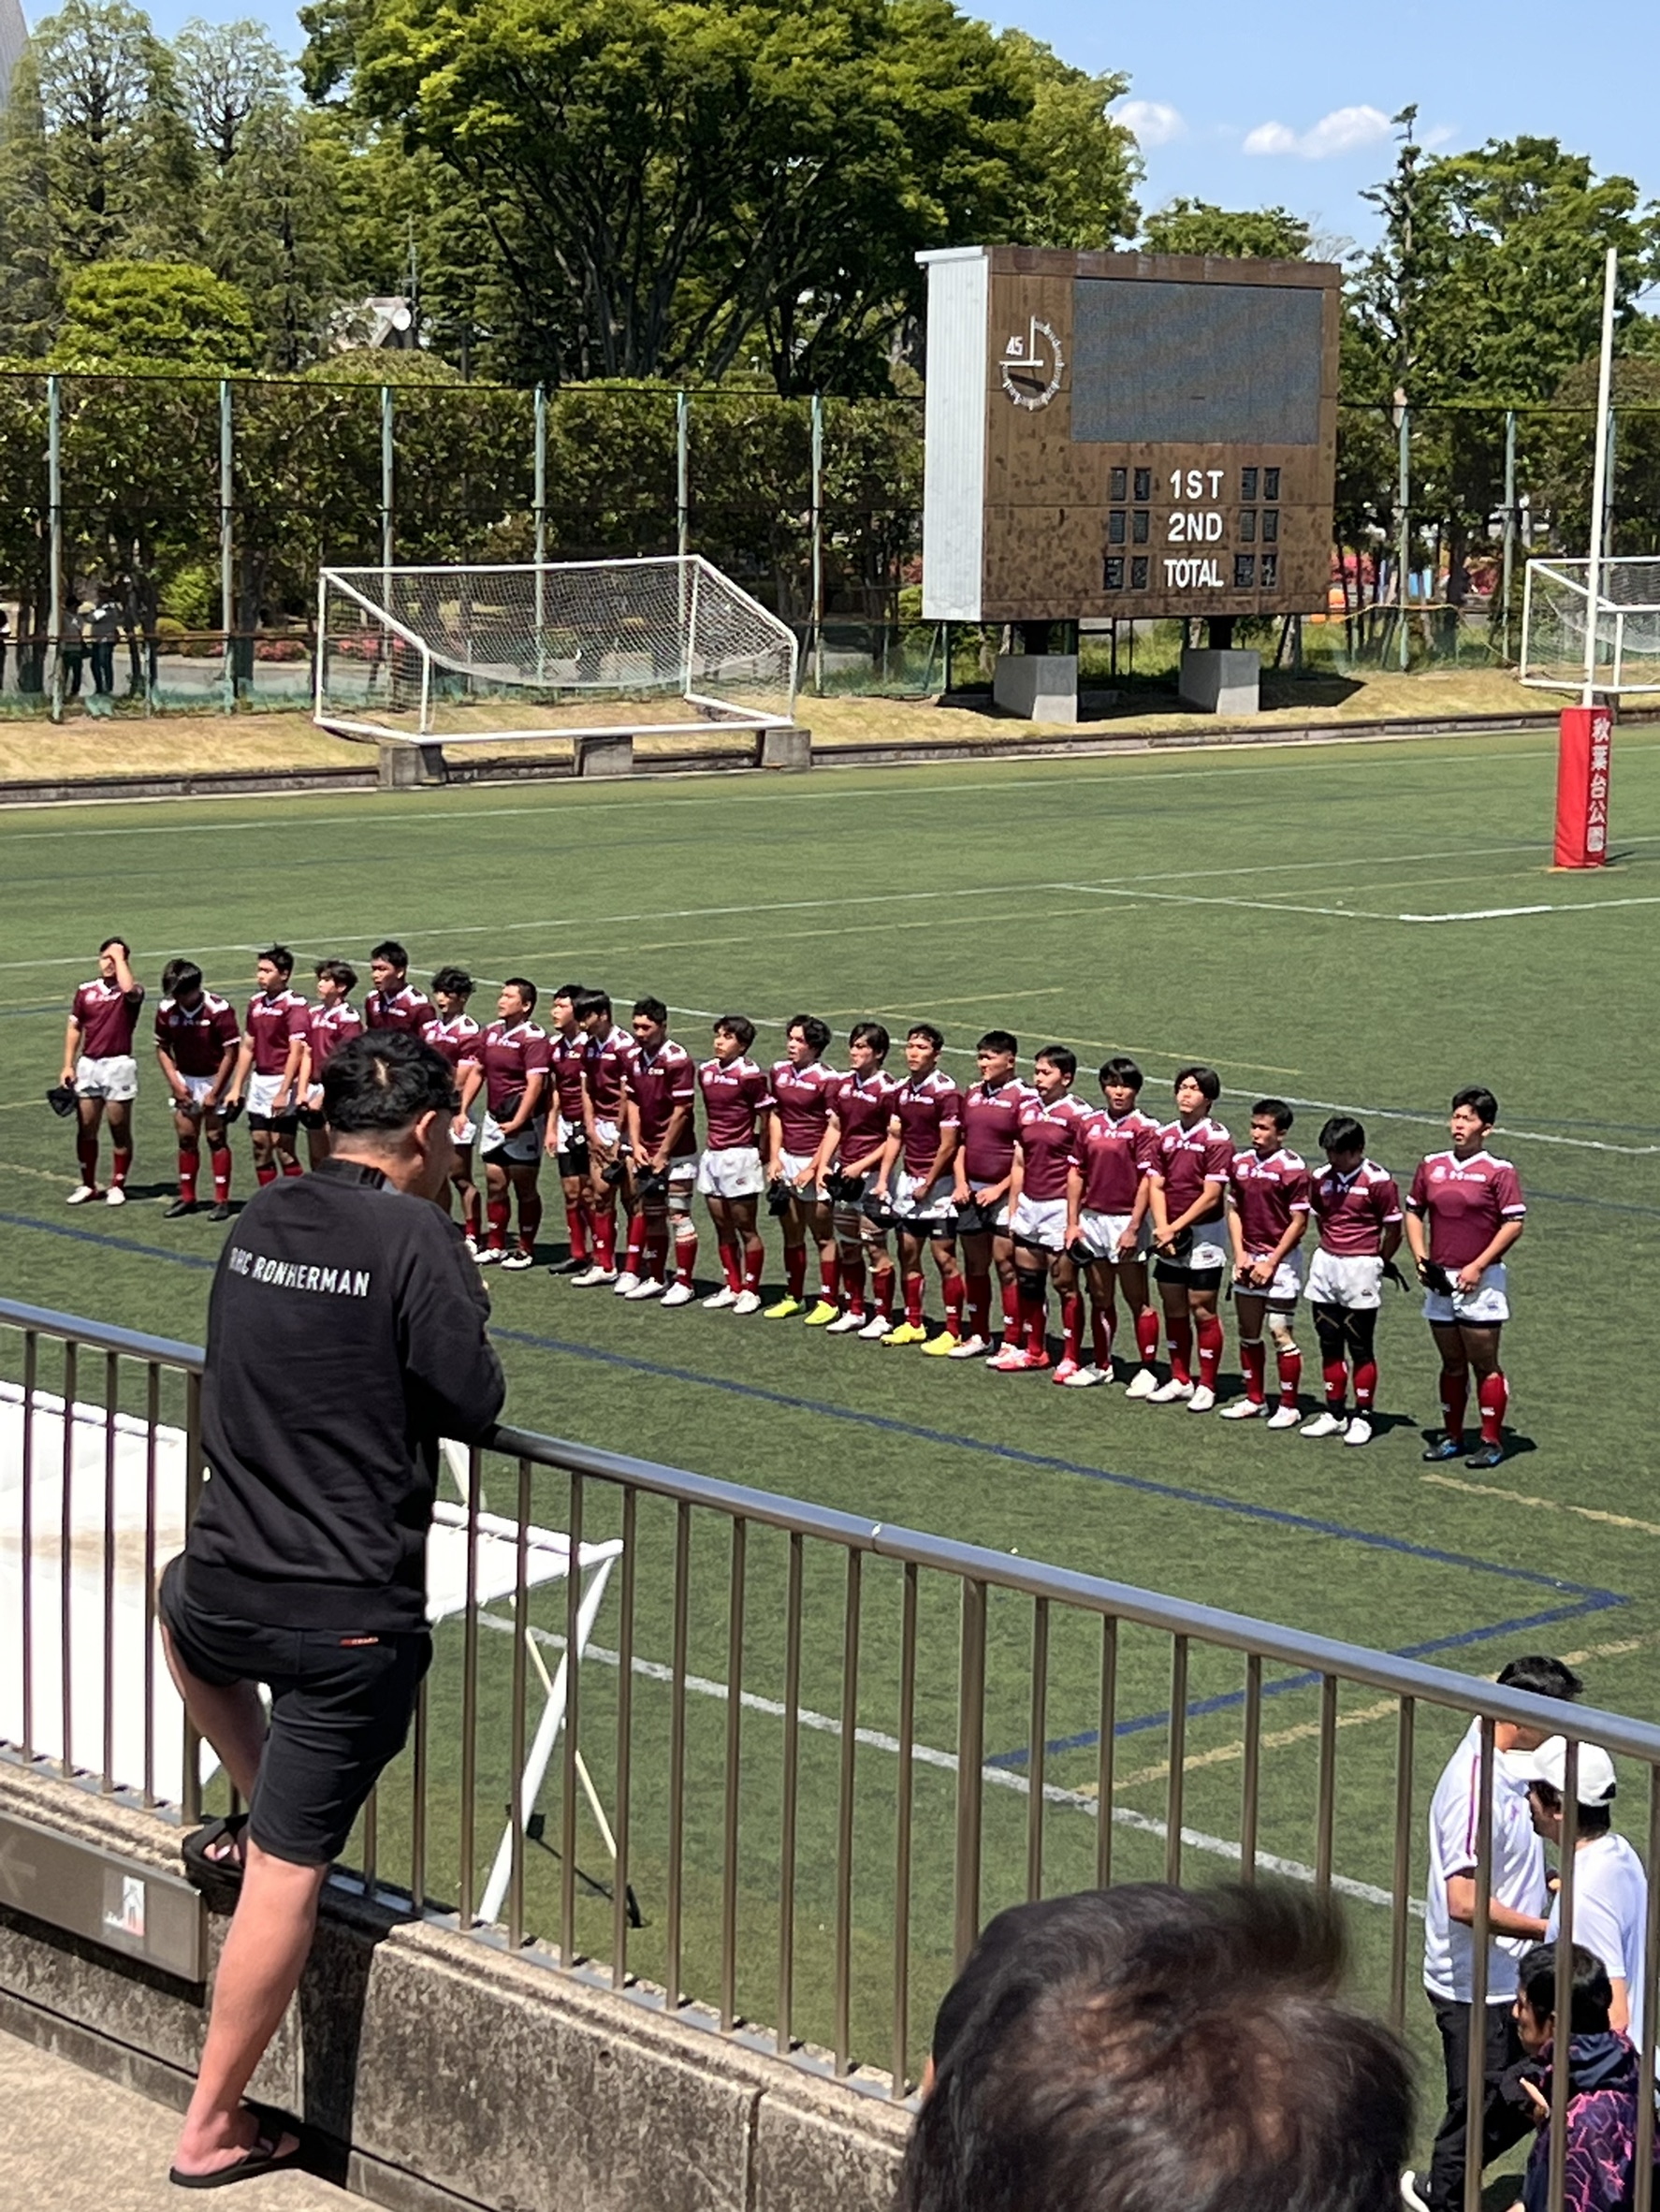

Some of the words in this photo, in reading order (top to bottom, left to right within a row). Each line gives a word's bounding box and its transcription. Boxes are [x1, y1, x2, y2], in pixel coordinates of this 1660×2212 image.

[1006, 336, 1023, 356] 45
[1170, 469, 1224, 499] 1ST
[1168, 512, 1223, 542] 2ND
[1163, 559, 1224, 589] TOTAL
